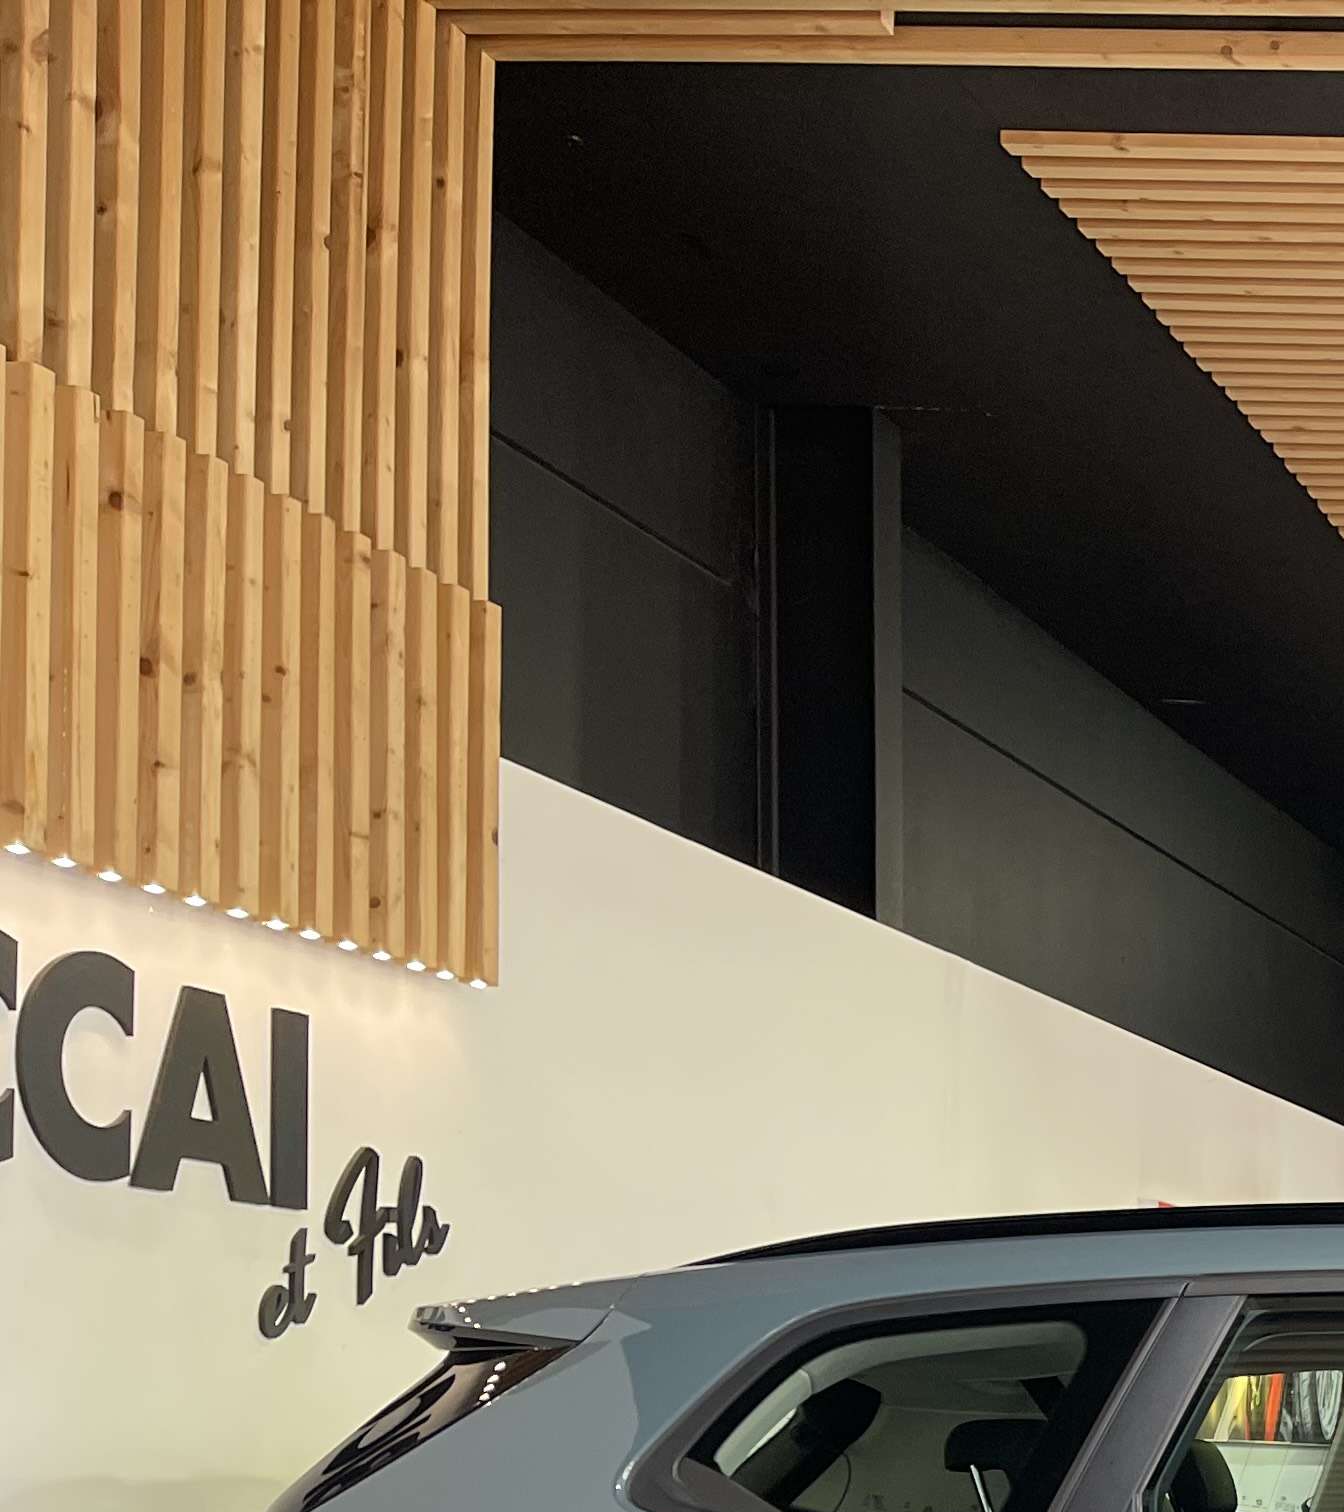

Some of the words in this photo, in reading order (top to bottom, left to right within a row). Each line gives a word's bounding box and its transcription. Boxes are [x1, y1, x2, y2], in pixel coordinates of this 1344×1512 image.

[0, 928, 310, 1211] CAI
[258, 1227, 316, 1339] et
[324, 1146, 450, 1306] Fils
